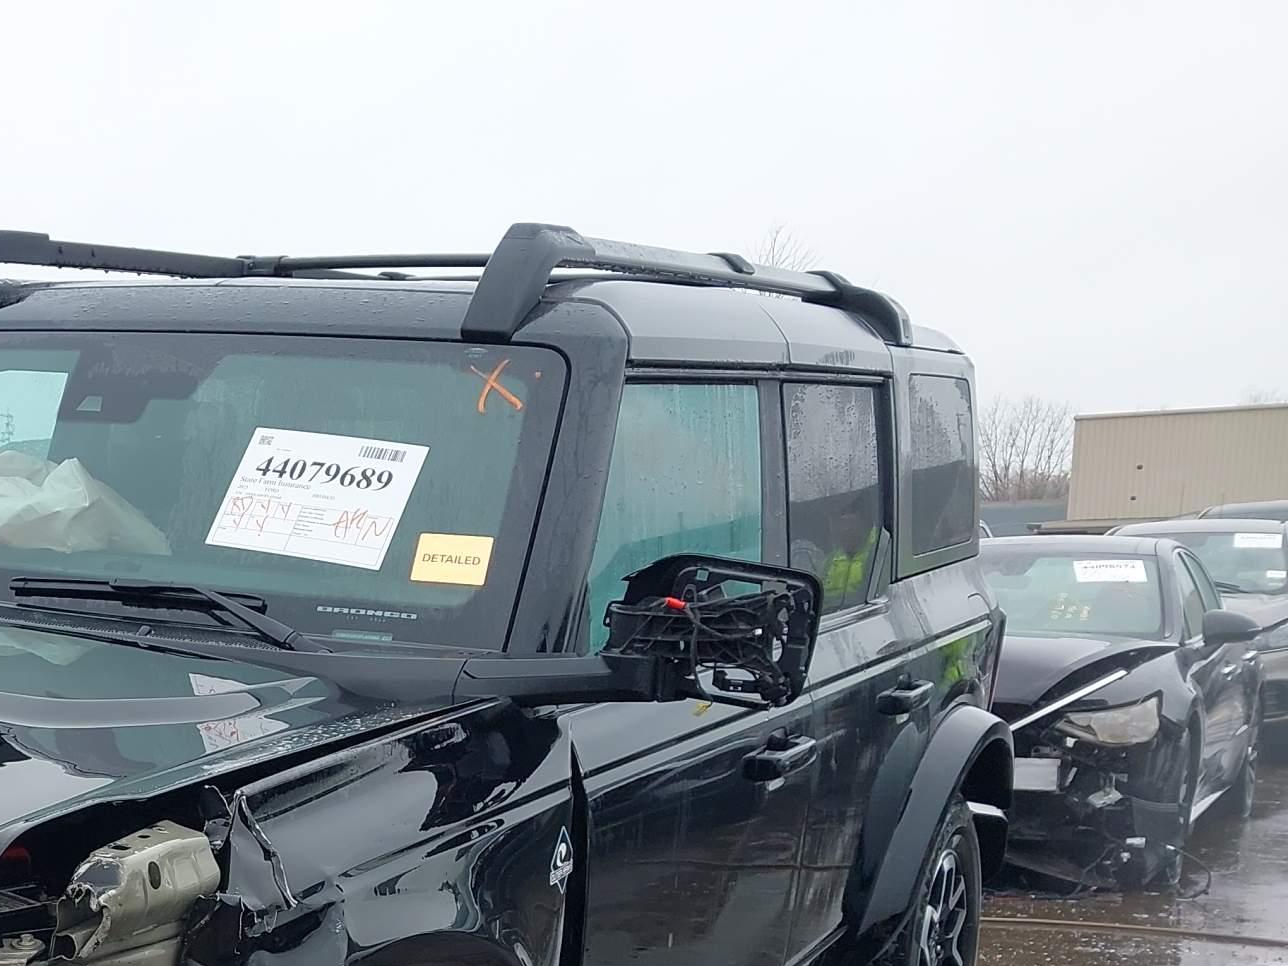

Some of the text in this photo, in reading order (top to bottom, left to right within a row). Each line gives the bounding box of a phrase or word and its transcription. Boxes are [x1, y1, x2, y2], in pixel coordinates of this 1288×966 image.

[255, 455, 394, 492] 44079689
[239, 475, 258, 484] State
[258, 478, 277, 487] Farm
[277, 479, 312, 491] Insurance
[421, 553, 481, 566] DETAILED
[316, 605, 418, 620] BRONCO
